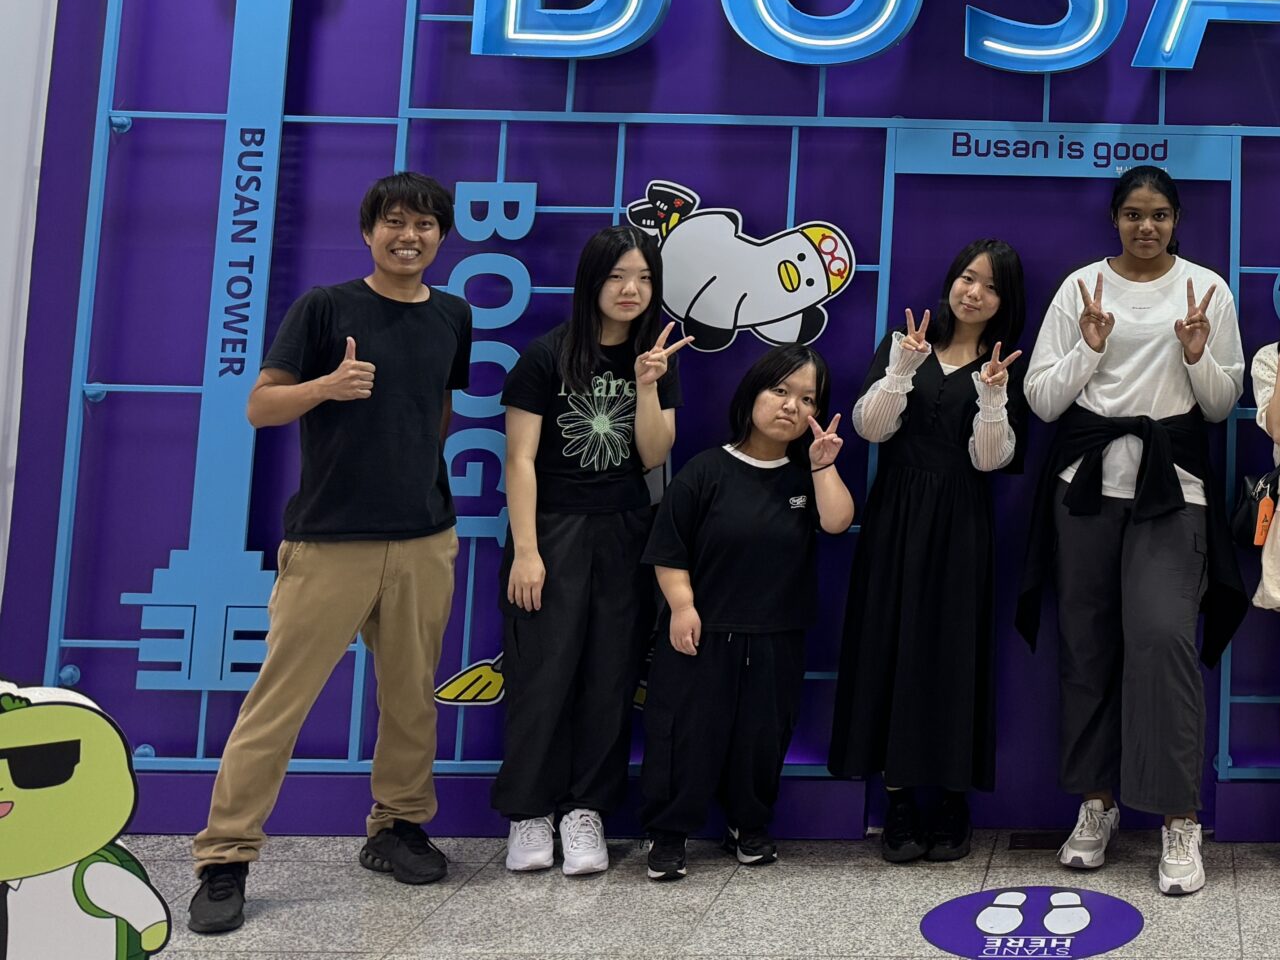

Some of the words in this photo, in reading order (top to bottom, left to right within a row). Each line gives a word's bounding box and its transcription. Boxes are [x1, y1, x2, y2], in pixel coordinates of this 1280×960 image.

[951, 131, 1049, 159] Busan
[1058, 134, 1084, 160] is
[1093, 139, 1168, 168] good
[230, 127, 266, 244] BUSAN
[218, 255, 255, 378] TOWER
[982, 947, 1071, 956] STAND
[984, 938, 1072, 948] HERE
